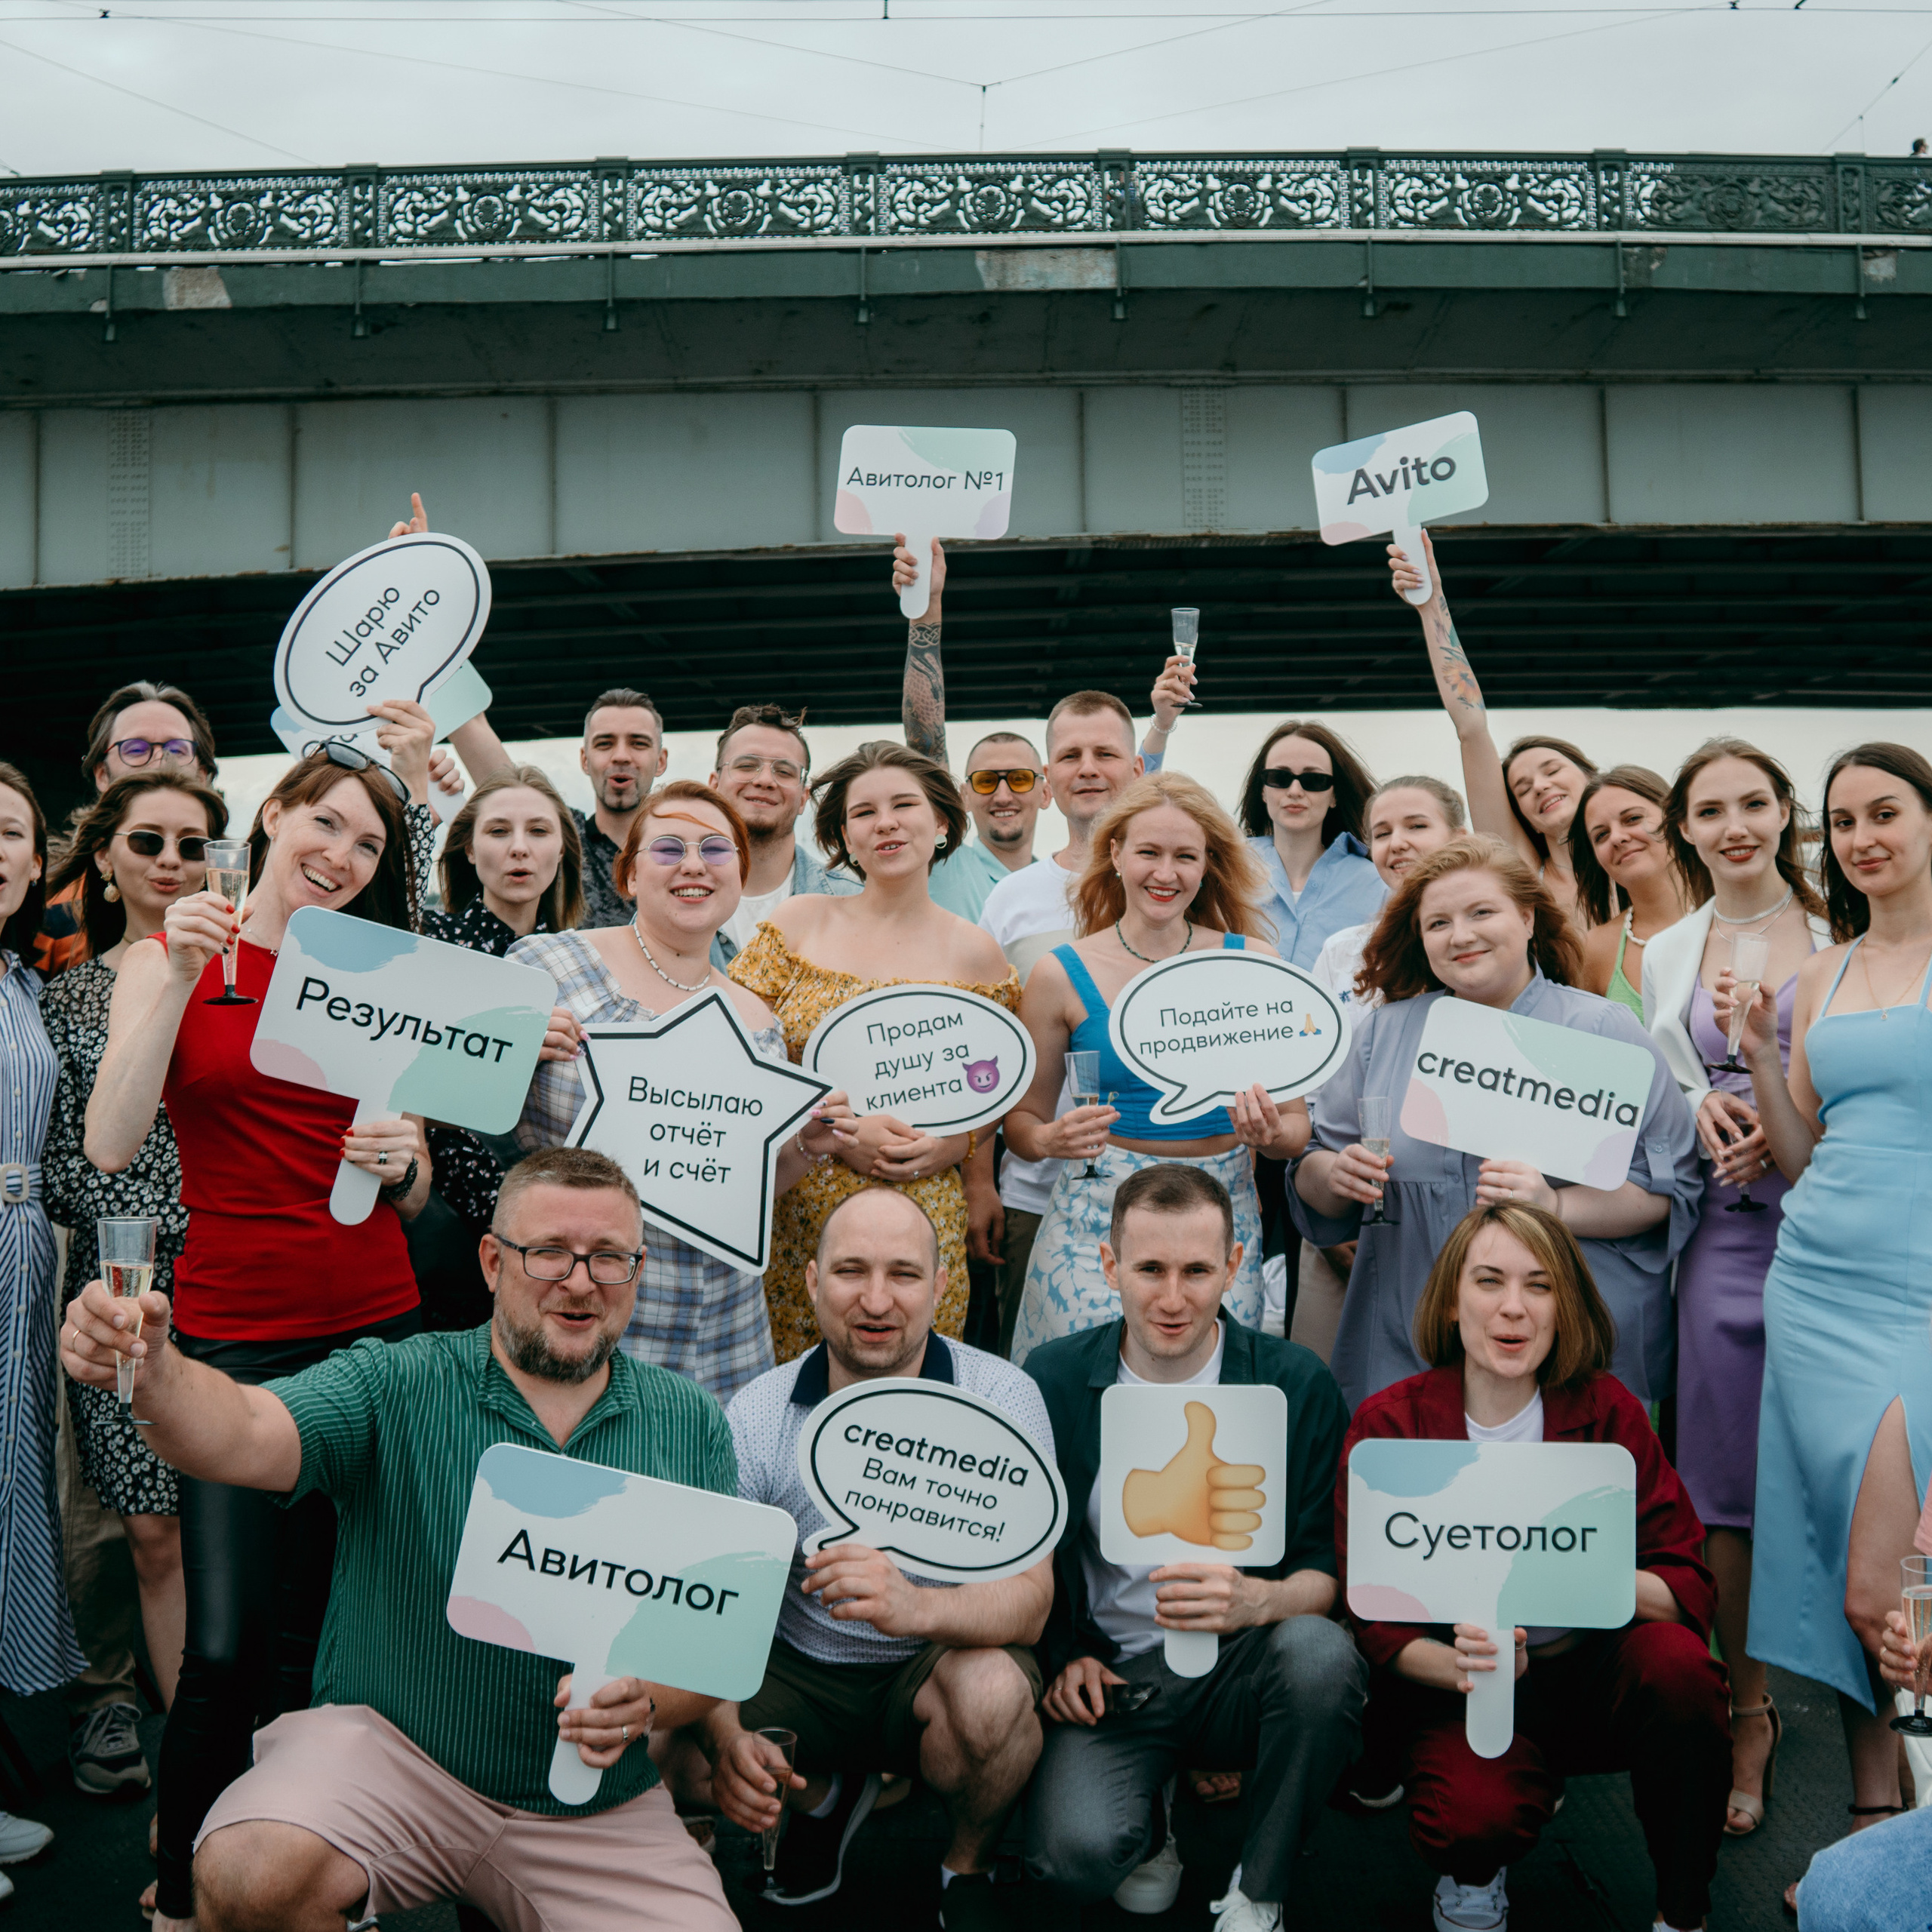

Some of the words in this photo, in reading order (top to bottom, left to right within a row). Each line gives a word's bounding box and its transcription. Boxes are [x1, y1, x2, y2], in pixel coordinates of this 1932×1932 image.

[846, 466, 956, 488] Авитолог
[964, 470, 1004, 491] №1
[1347, 456, 1457, 505] Avito
[325, 586, 400, 666] Шарю
[349, 665, 379, 697] за
[375, 589, 440, 665] Авито
[295, 976, 513, 1063] Результат
[866, 1013, 963, 1046] Продам
[1160, 1001, 1258, 1027] Подайте
[1266, 1000, 1294, 1015] на
[875, 1051, 934, 1079] душу
[942, 1044, 970, 1061] за
[1140, 1026, 1294, 1059] продвижение
[628, 1076, 763, 1116] Высылаю
[866, 1078, 962, 1110] клиента
[1417, 1052, 1639, 1128] creatmedia
[650, 1121, 726, 1147] отчёт
[644, 1158, 660, 1177] и
[669, 1158, 731, 1183] счёт
[844, 1424, 1029, 1487] creatmedia
[863, 1458, 917, 1490] Вам
[926, 1478, 998, 1509] точно
[844, 1491, 1005, 1543] понравится!
[1385, 1512, 1598, 1561] Суетолог
[497, 1529, 739, 1615] Авитолог
